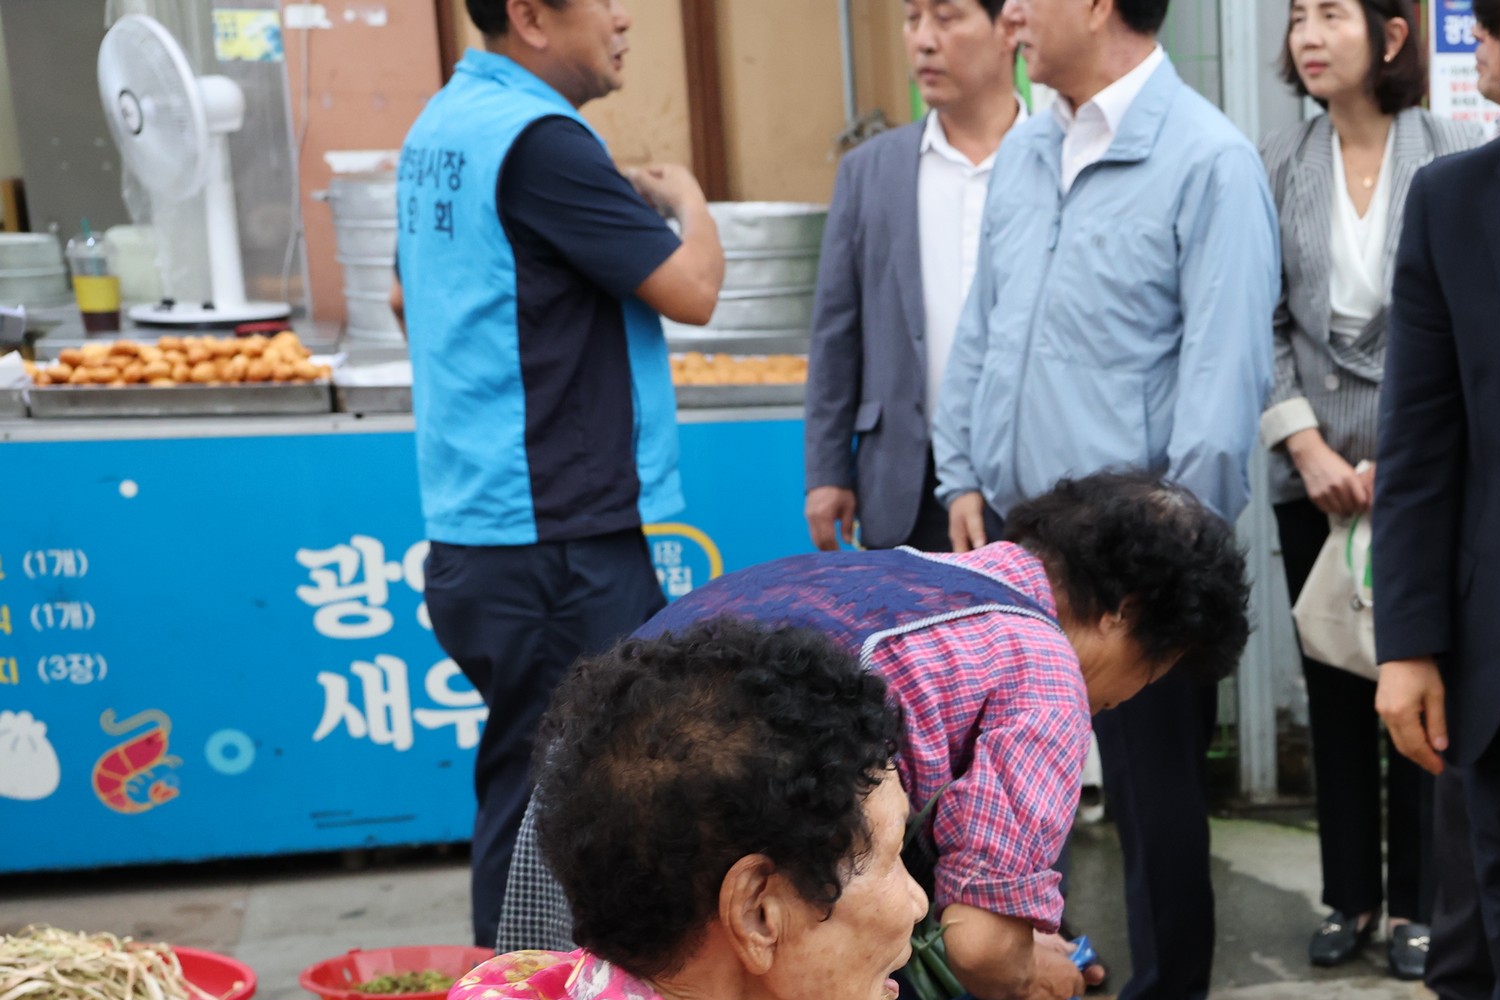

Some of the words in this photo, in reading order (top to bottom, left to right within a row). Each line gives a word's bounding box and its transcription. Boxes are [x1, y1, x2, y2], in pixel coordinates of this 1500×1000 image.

[23, 548, 89, 580] (1개)
[30, 601, 96, 632] (1개)
[37, 653, 108, 685] (3장)
